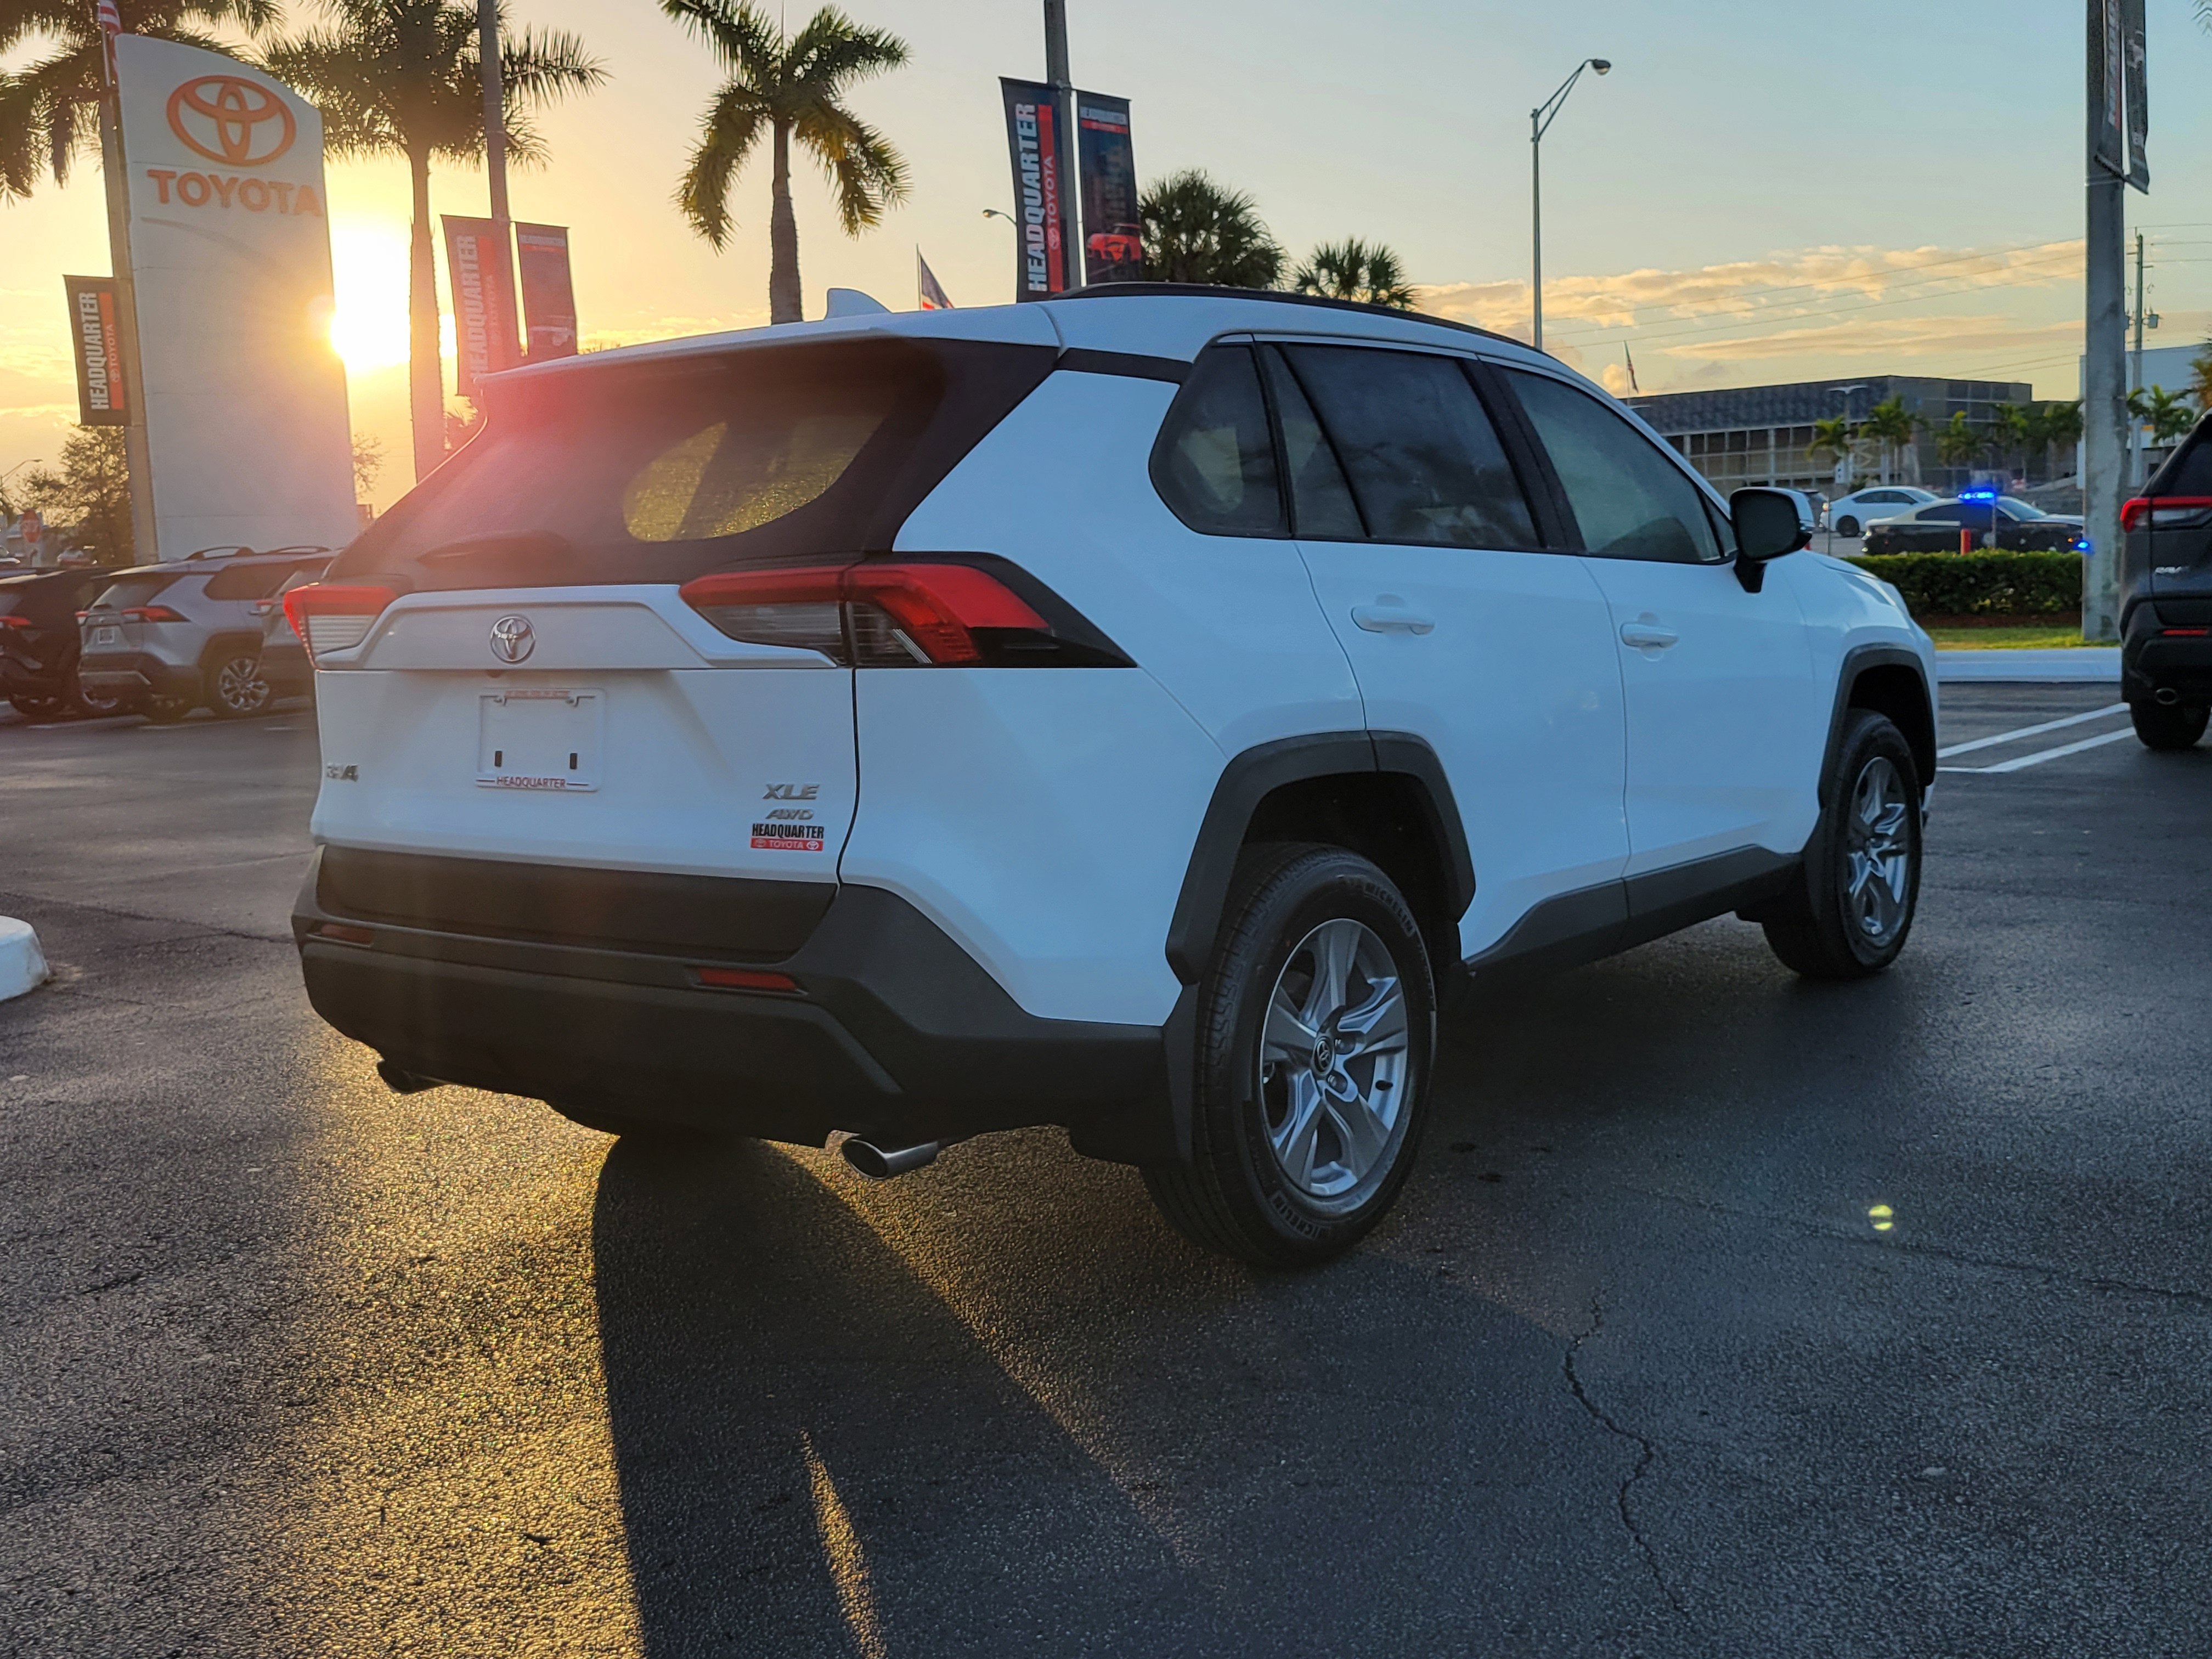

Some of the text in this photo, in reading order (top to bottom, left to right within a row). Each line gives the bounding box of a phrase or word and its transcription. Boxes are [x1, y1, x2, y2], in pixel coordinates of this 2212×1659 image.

[146, 169, 324, 217] TOYOTA
[1015, 103, 1048, 292] HEADQUARTER
[1043, 156, 1059, 224] TOYOTA
[456, 236, 489, 379] HEADQUARTER
[78, 291, 109, 410] HEADQUARTER
[107, 324, 120, 368] TOYOTA
[495, 776, 566, 788] HEADQUARTER
[763, 783, 820, 800] XLE
[752, 823, 825, 839] HEADQUARTER
[765, 808, 814, 820] AWD
[769, 840, 804, 849] TOYOTA
[1364, 882, 1415, 936] MICHELIN
